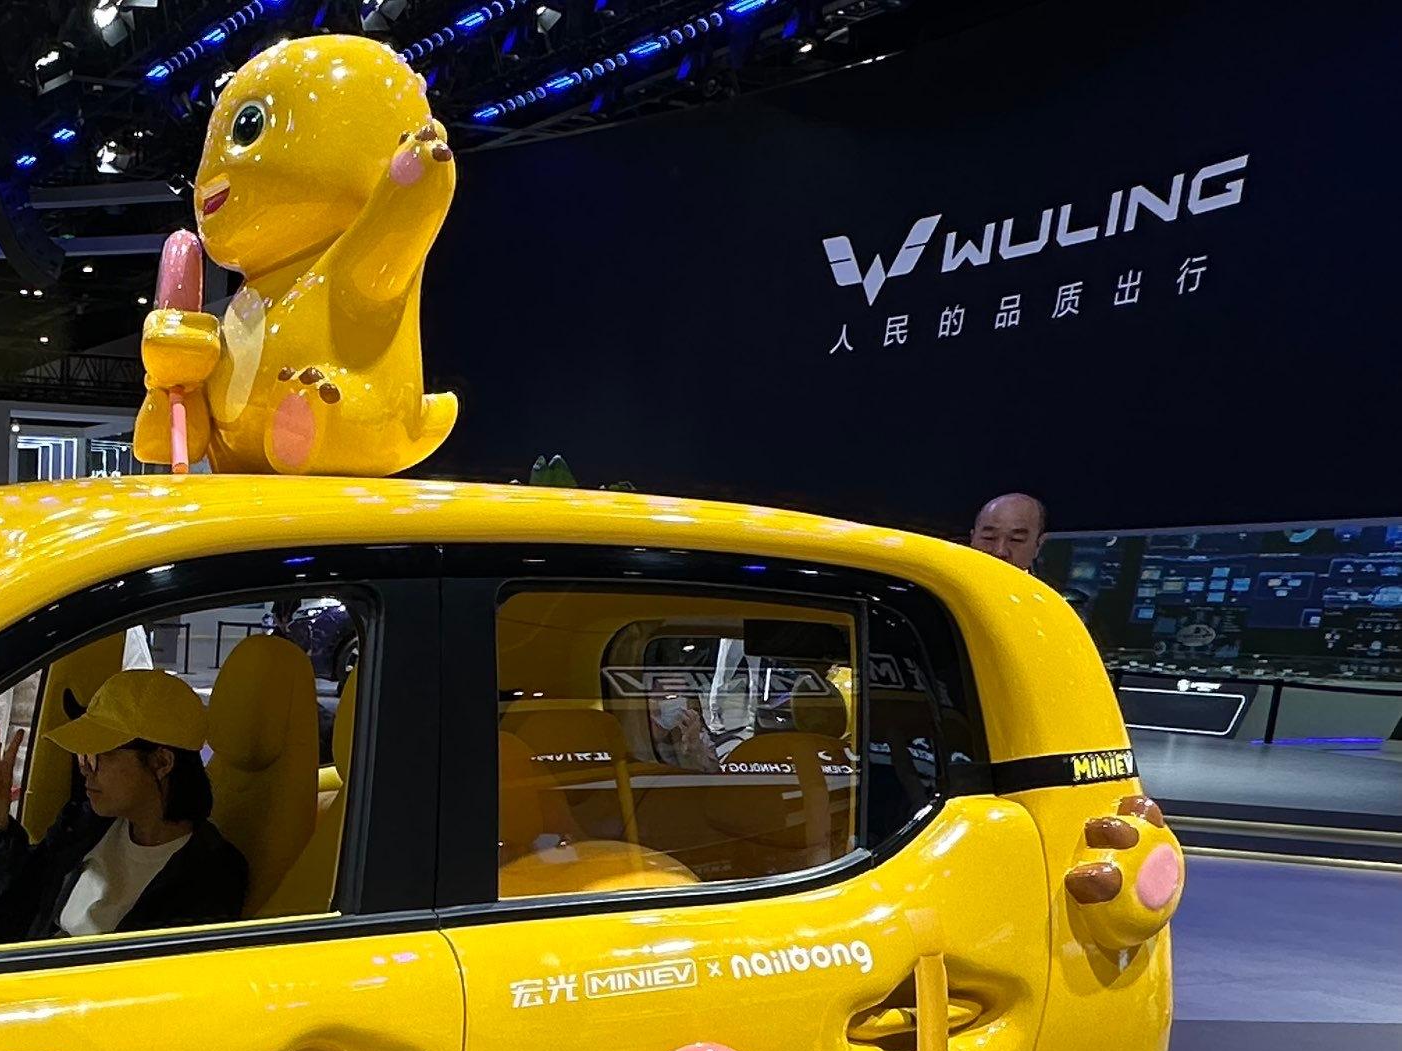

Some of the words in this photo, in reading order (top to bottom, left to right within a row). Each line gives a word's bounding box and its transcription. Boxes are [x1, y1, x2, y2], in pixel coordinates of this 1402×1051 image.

[940, 154, 1250, 273] WULING
[829, 255, 1208, 354] 人民的品质出行
[1072, 752, 1134, 781] MINIEV
[509, 973, 578, 1009] 宏光
[588, 962, 695, 994] MINIEV
